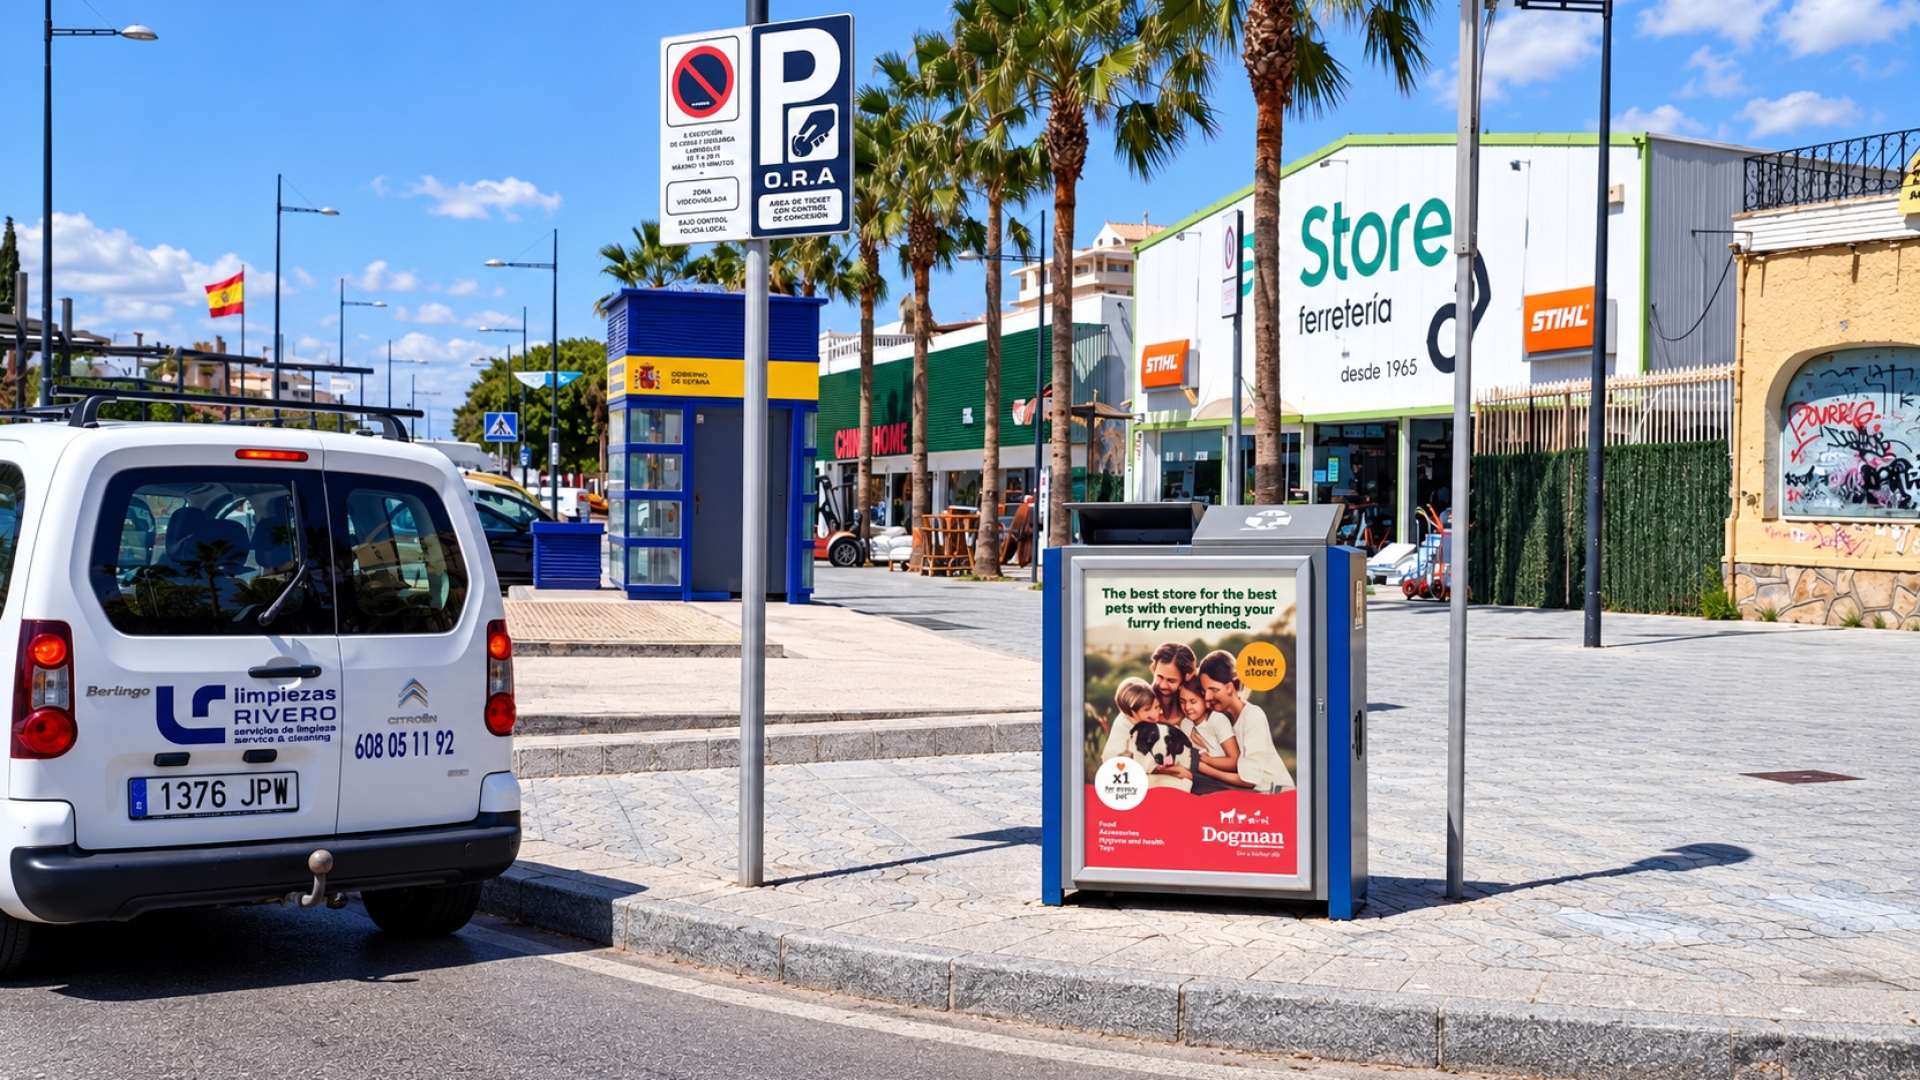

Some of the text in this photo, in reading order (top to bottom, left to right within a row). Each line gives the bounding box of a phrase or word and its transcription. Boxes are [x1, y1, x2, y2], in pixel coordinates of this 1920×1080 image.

[759, 27, 841, 166] P
[764, 167, 836, 189] O.R.A
[692, 188, 712, 196] ZONA
[805, 195, 832, 204] TICKET
[774, 207, 790, 215] CON
[705, 225, 727, 233] LOCAL
[1299, 197, 1452, 288] Store
[1299, 292, 1392, 335] ferretería
[1531, 305, 1589, 332] STIHL
[1145, 354, 1178, 374] STIHL
[1341, 358, 1418, 383] desde 1965
[835, 422, 908, 459] CHIN HOME
[1102, 588, 1277, 600] The best store for the best
[1105, 602, 1275, 617] pets with everything your
[1127, 617, 1251, 631] furry friend needs.
[1247, 656, 1275, 667] New
[1244, 667, 1278, 677] store!
[85, 685, 151, 699] Berlingo
[234, 687, 337, 707] limpiezas
[234, 706, 337, 725] RIVERO
[354, 729, 454, 760] 608 05 11 92
[1113, 772, 1130, 784] x1
[161, 777, 288, 810] 1376 JPW
[1201, 826, 1284, 847] Dogman
